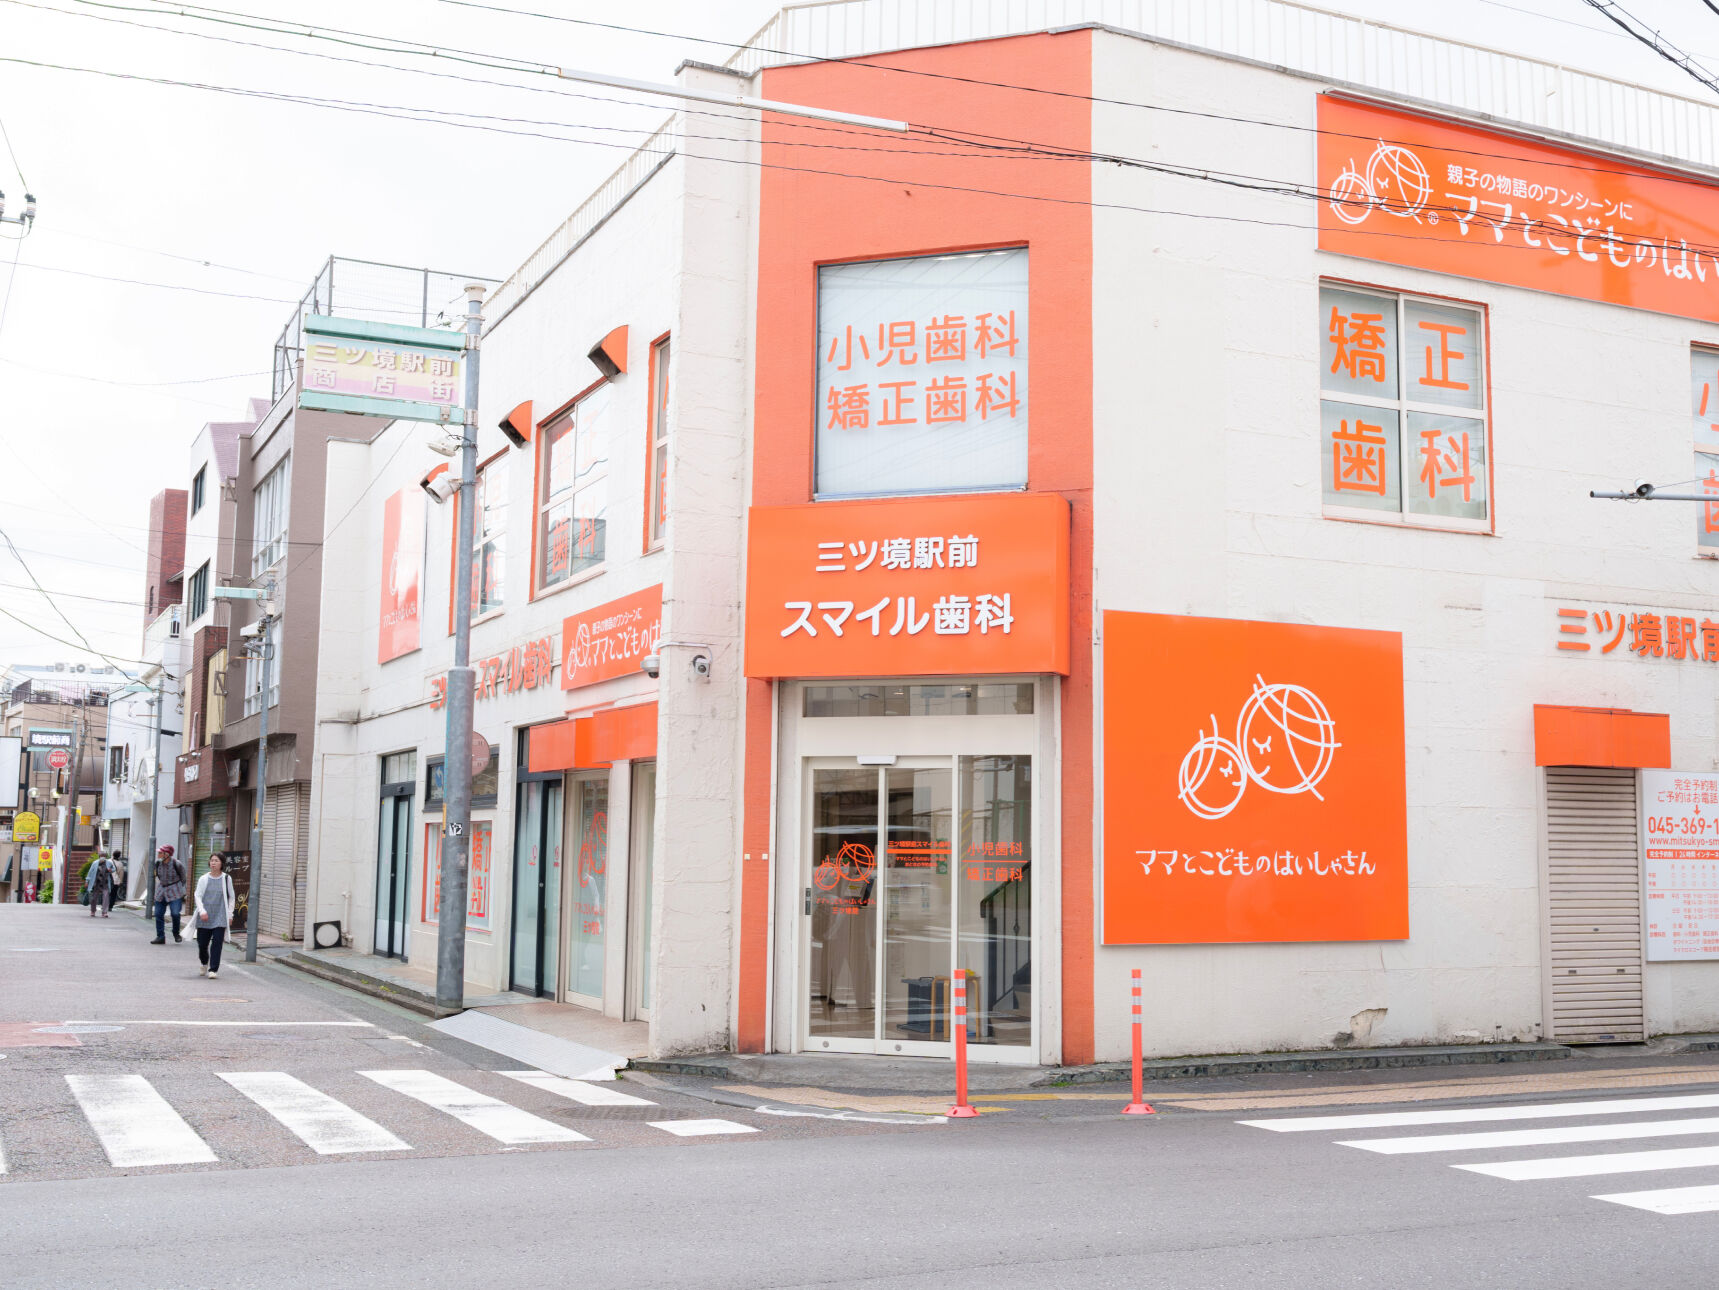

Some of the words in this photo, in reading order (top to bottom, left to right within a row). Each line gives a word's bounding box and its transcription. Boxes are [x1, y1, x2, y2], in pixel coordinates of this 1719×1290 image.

[1447, 164, 1634, 221] 親子の物語のワンシーンに
[827, 310, 1020, 371] 小児歯科
[1329, 306, 1470, 391] 矯正
[313, 342, 454, 377] 三ツ境駅前
[312, 368, 454, 401] 商店街
[827, 370, 1021, 430] 矯正歯科
[1331, 419, 1476, 503] 歯科
[815, 534, 979, 572] 三ツ境駅前
[780, 592, 1014, 638] スマイル歯科
[1657, 790, 1719, 804] ご予約はお電話
[1674, 778, 1718, 792] 完全予約制
[967, 841, 1023, 857] 小児歯科
[1135, 848, 1376, 876] ママとこどものはいしゃさん
[966, 867, 1023, 882] 矯正歯科
